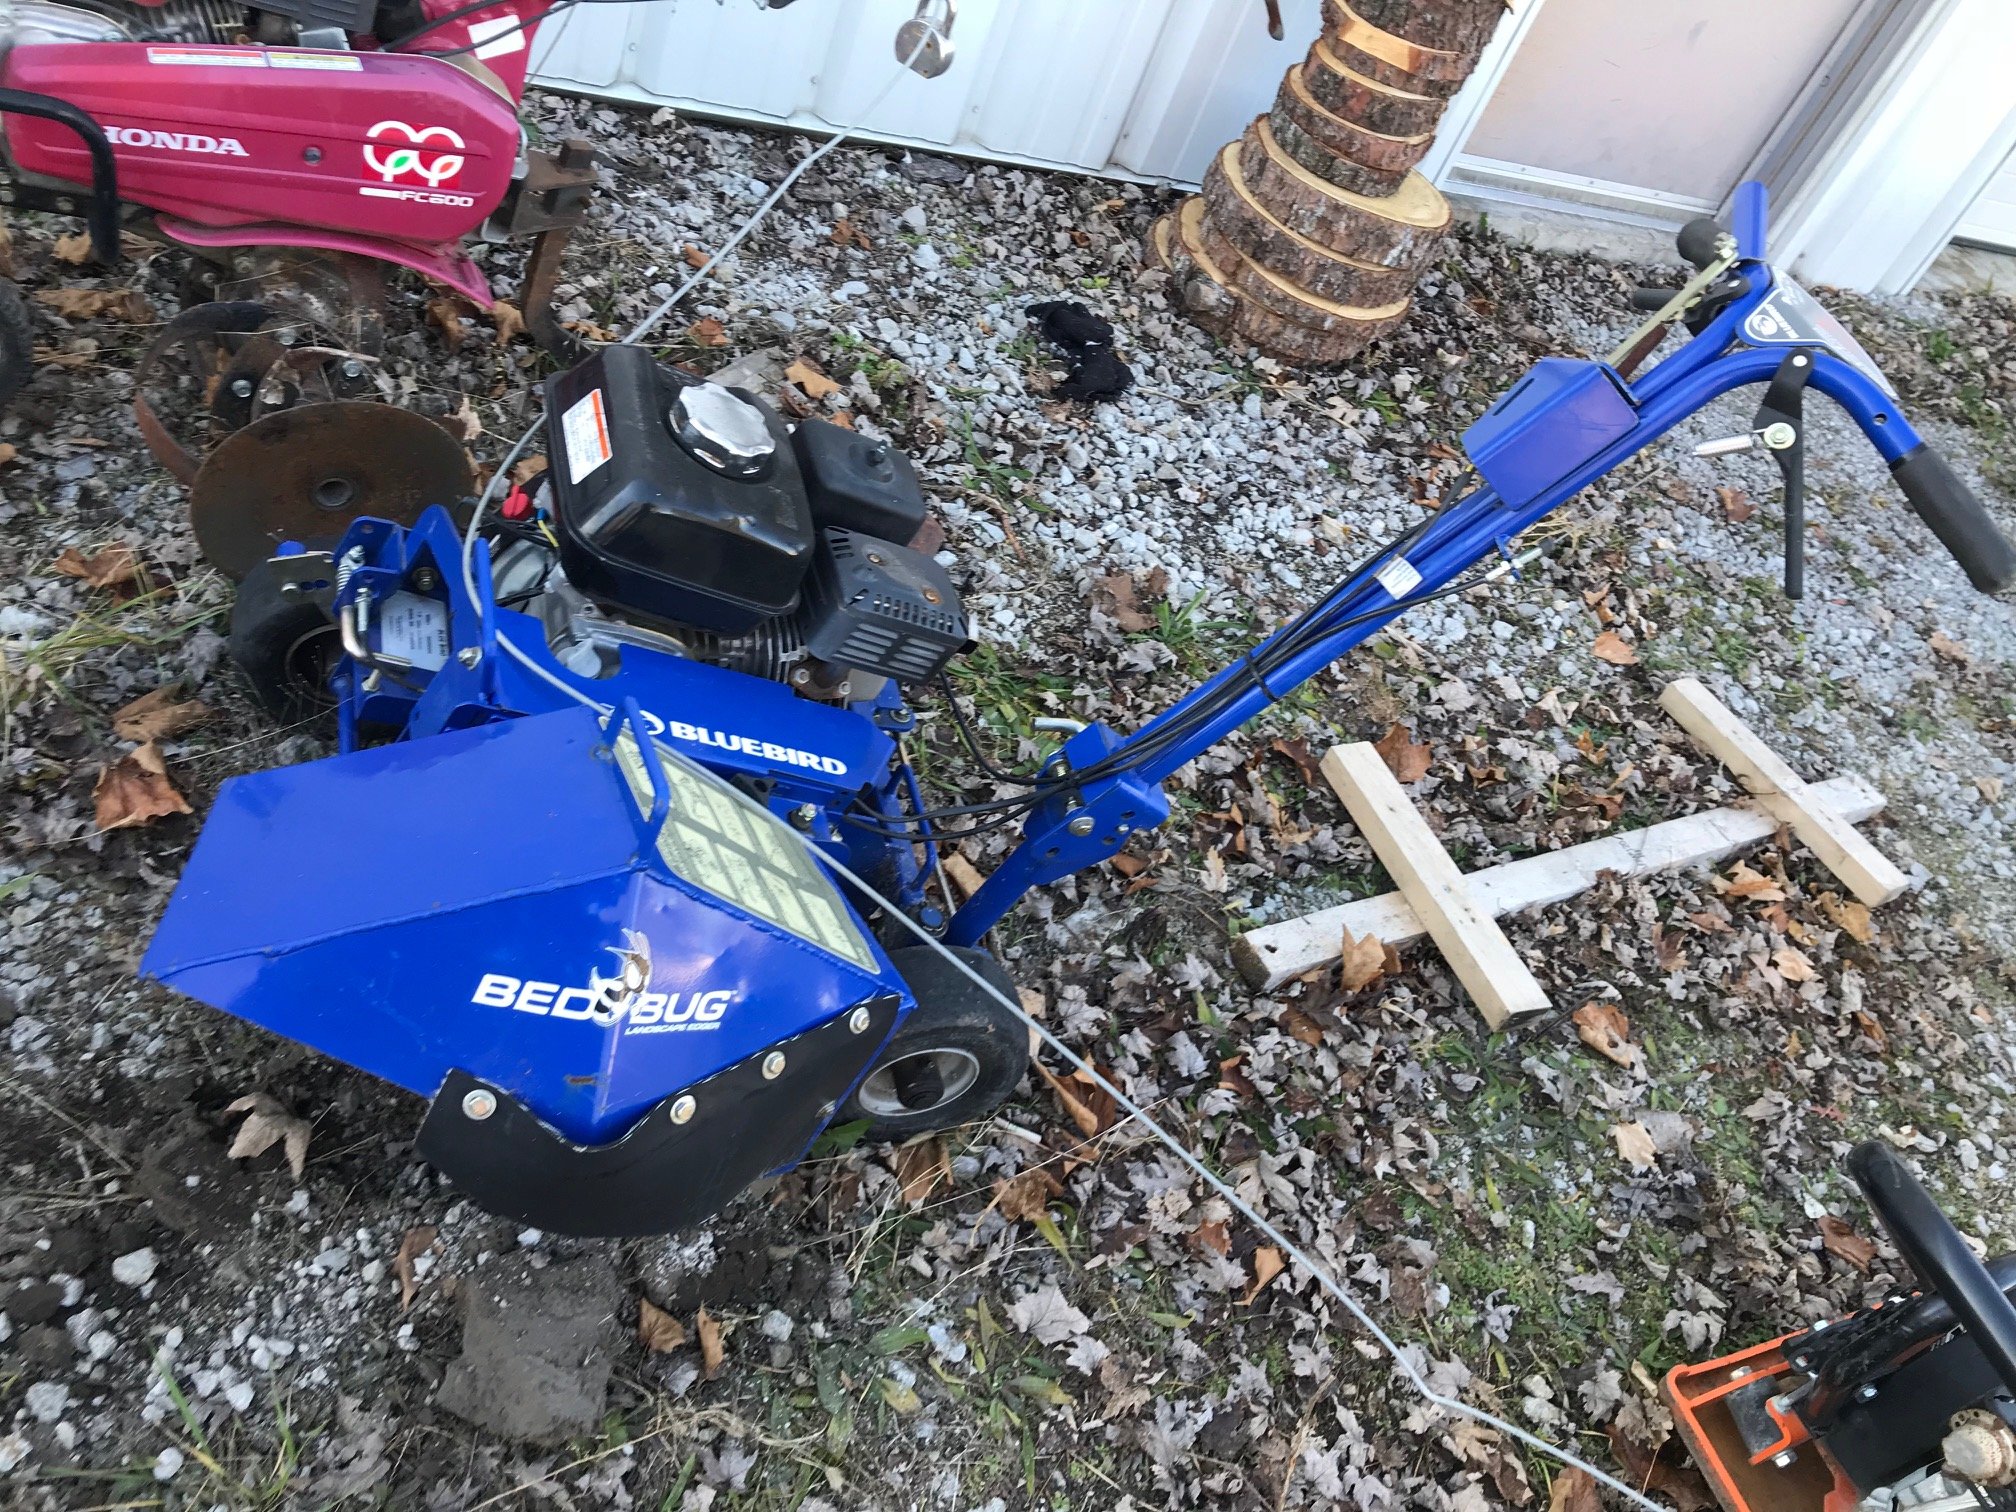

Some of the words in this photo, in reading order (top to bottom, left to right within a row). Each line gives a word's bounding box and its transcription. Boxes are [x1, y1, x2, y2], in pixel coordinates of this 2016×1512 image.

[669, 720, 848, 775] BLUEBIRD
[471, 973, 599, 1021] BED
[628, 989, 732, 1025] BUG
